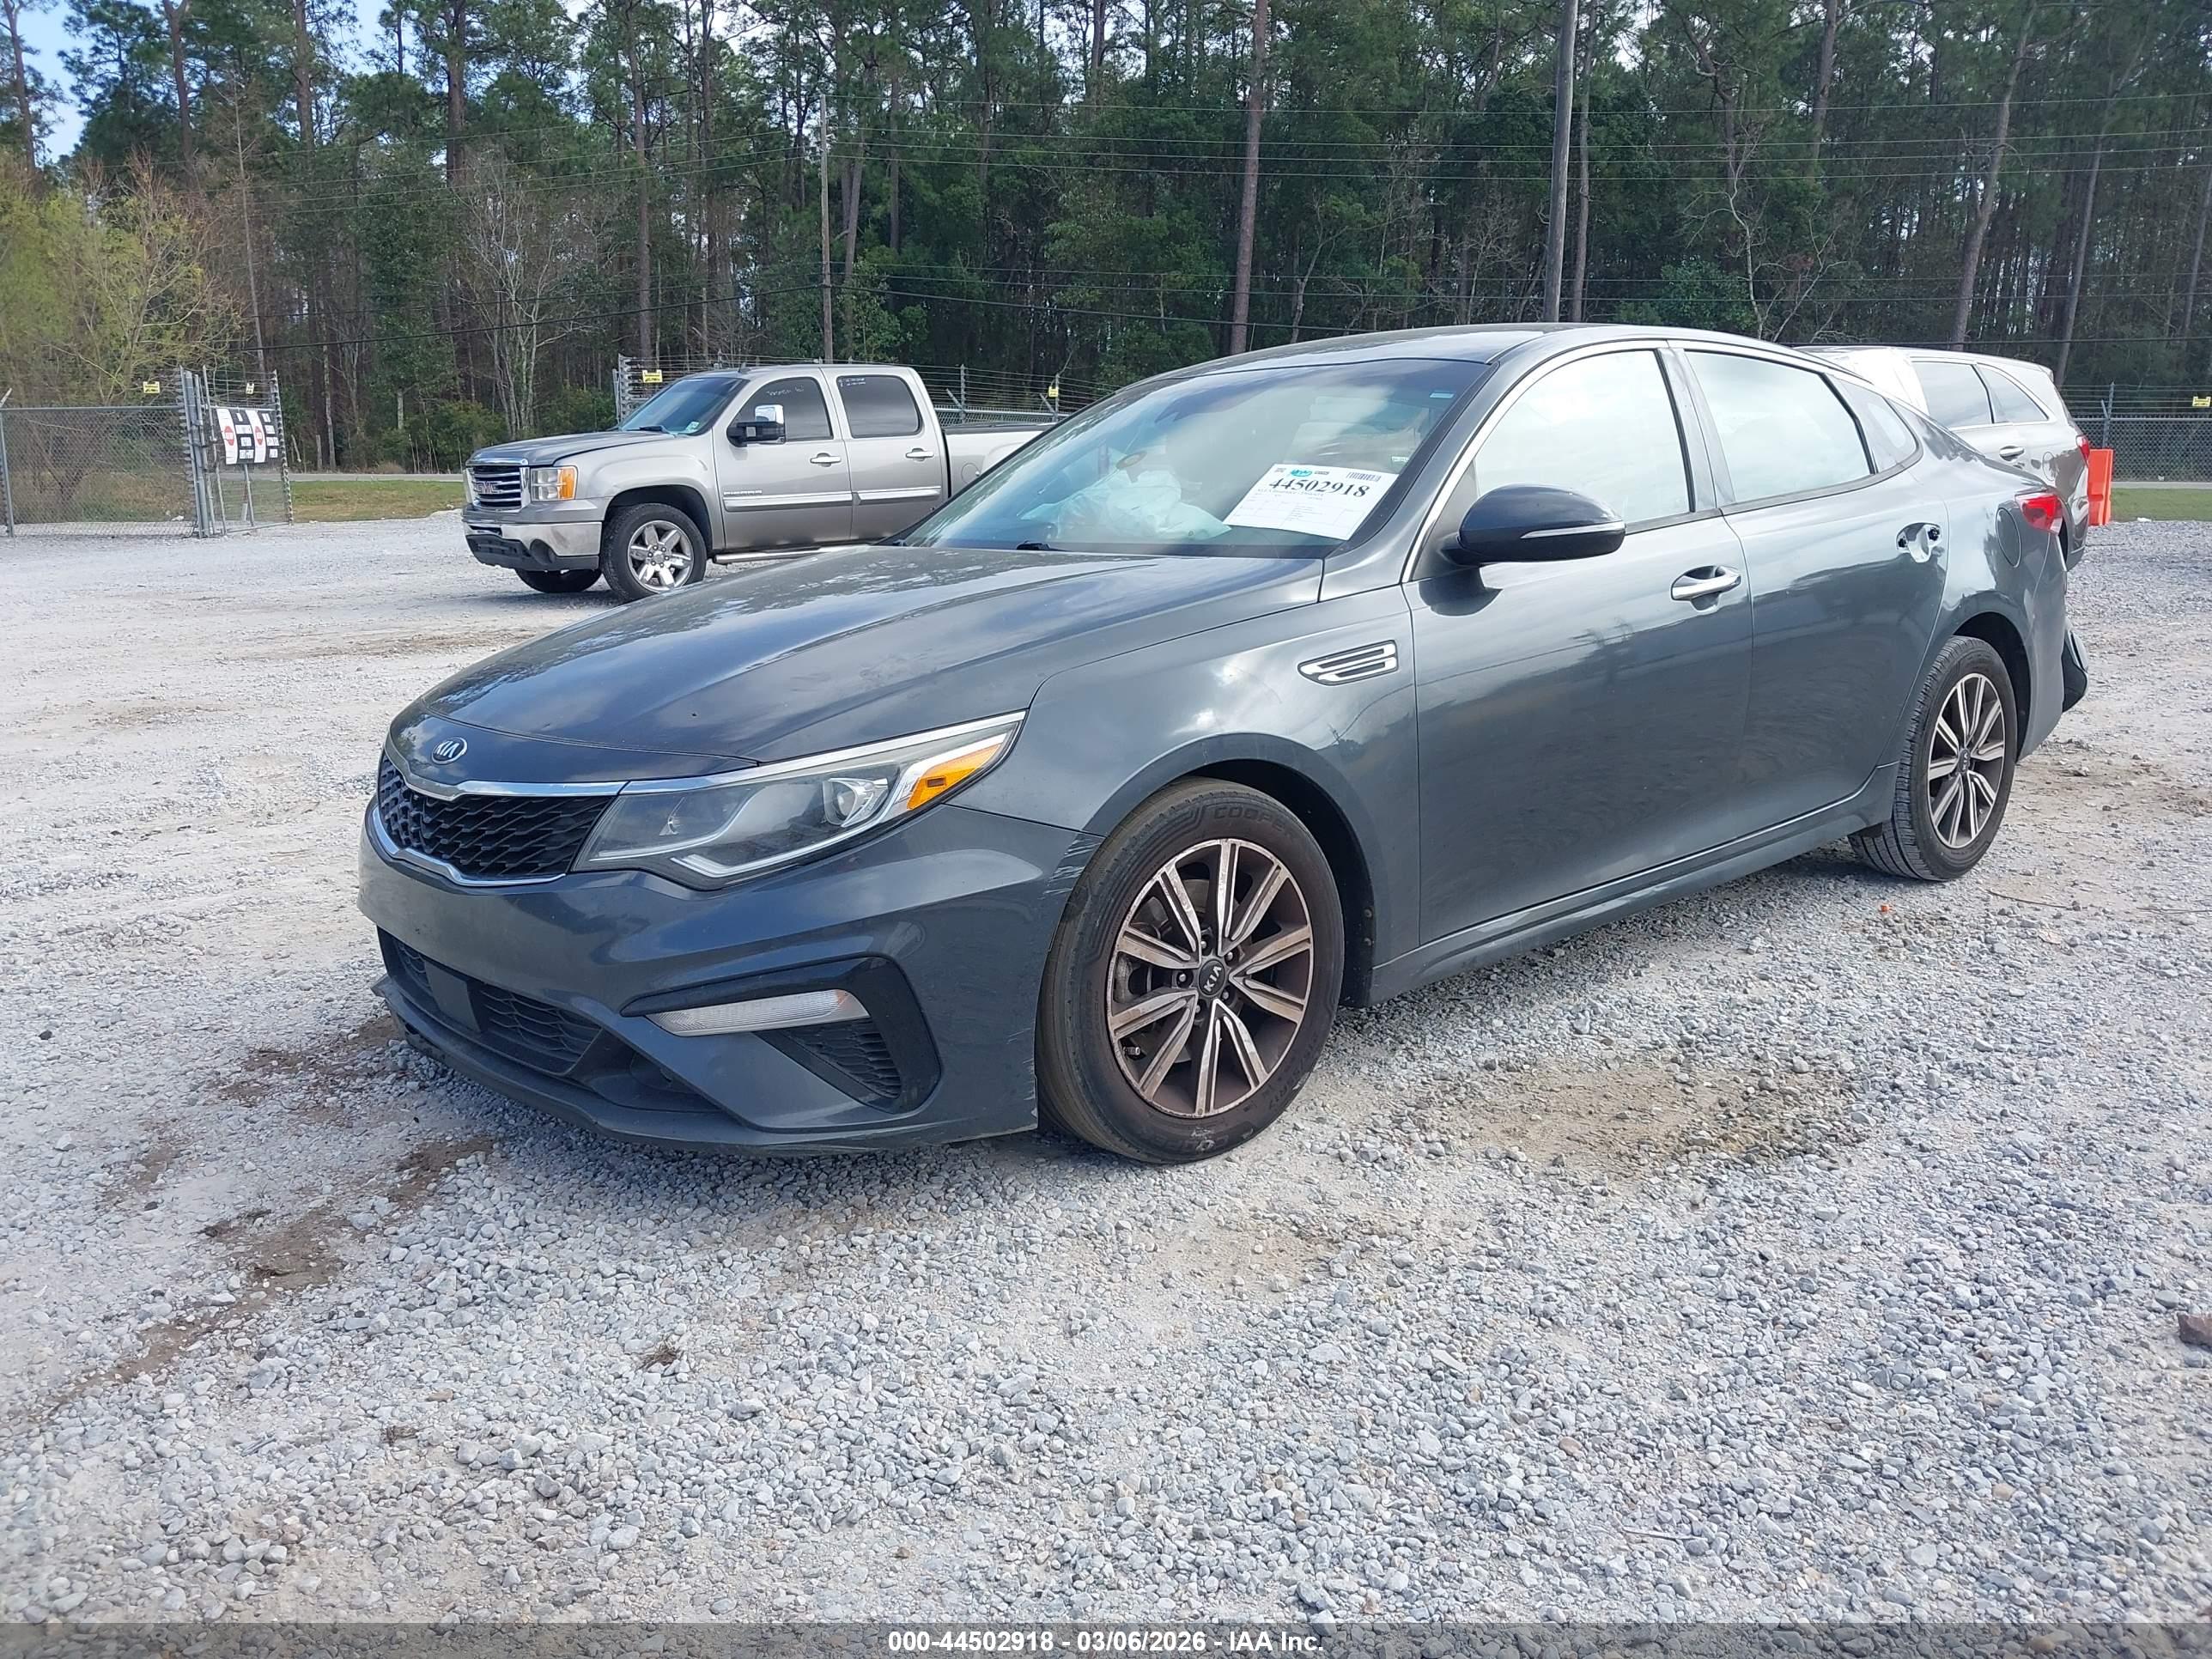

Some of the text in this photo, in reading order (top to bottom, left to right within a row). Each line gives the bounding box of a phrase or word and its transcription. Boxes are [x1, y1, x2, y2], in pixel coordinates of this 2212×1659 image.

[474, 481, 498, 495] GMC
[1269, 478, 1370, 497] 44502918
[434, 740, 460, 758] KIA
[1204, 966, 1222, 993] KIA
